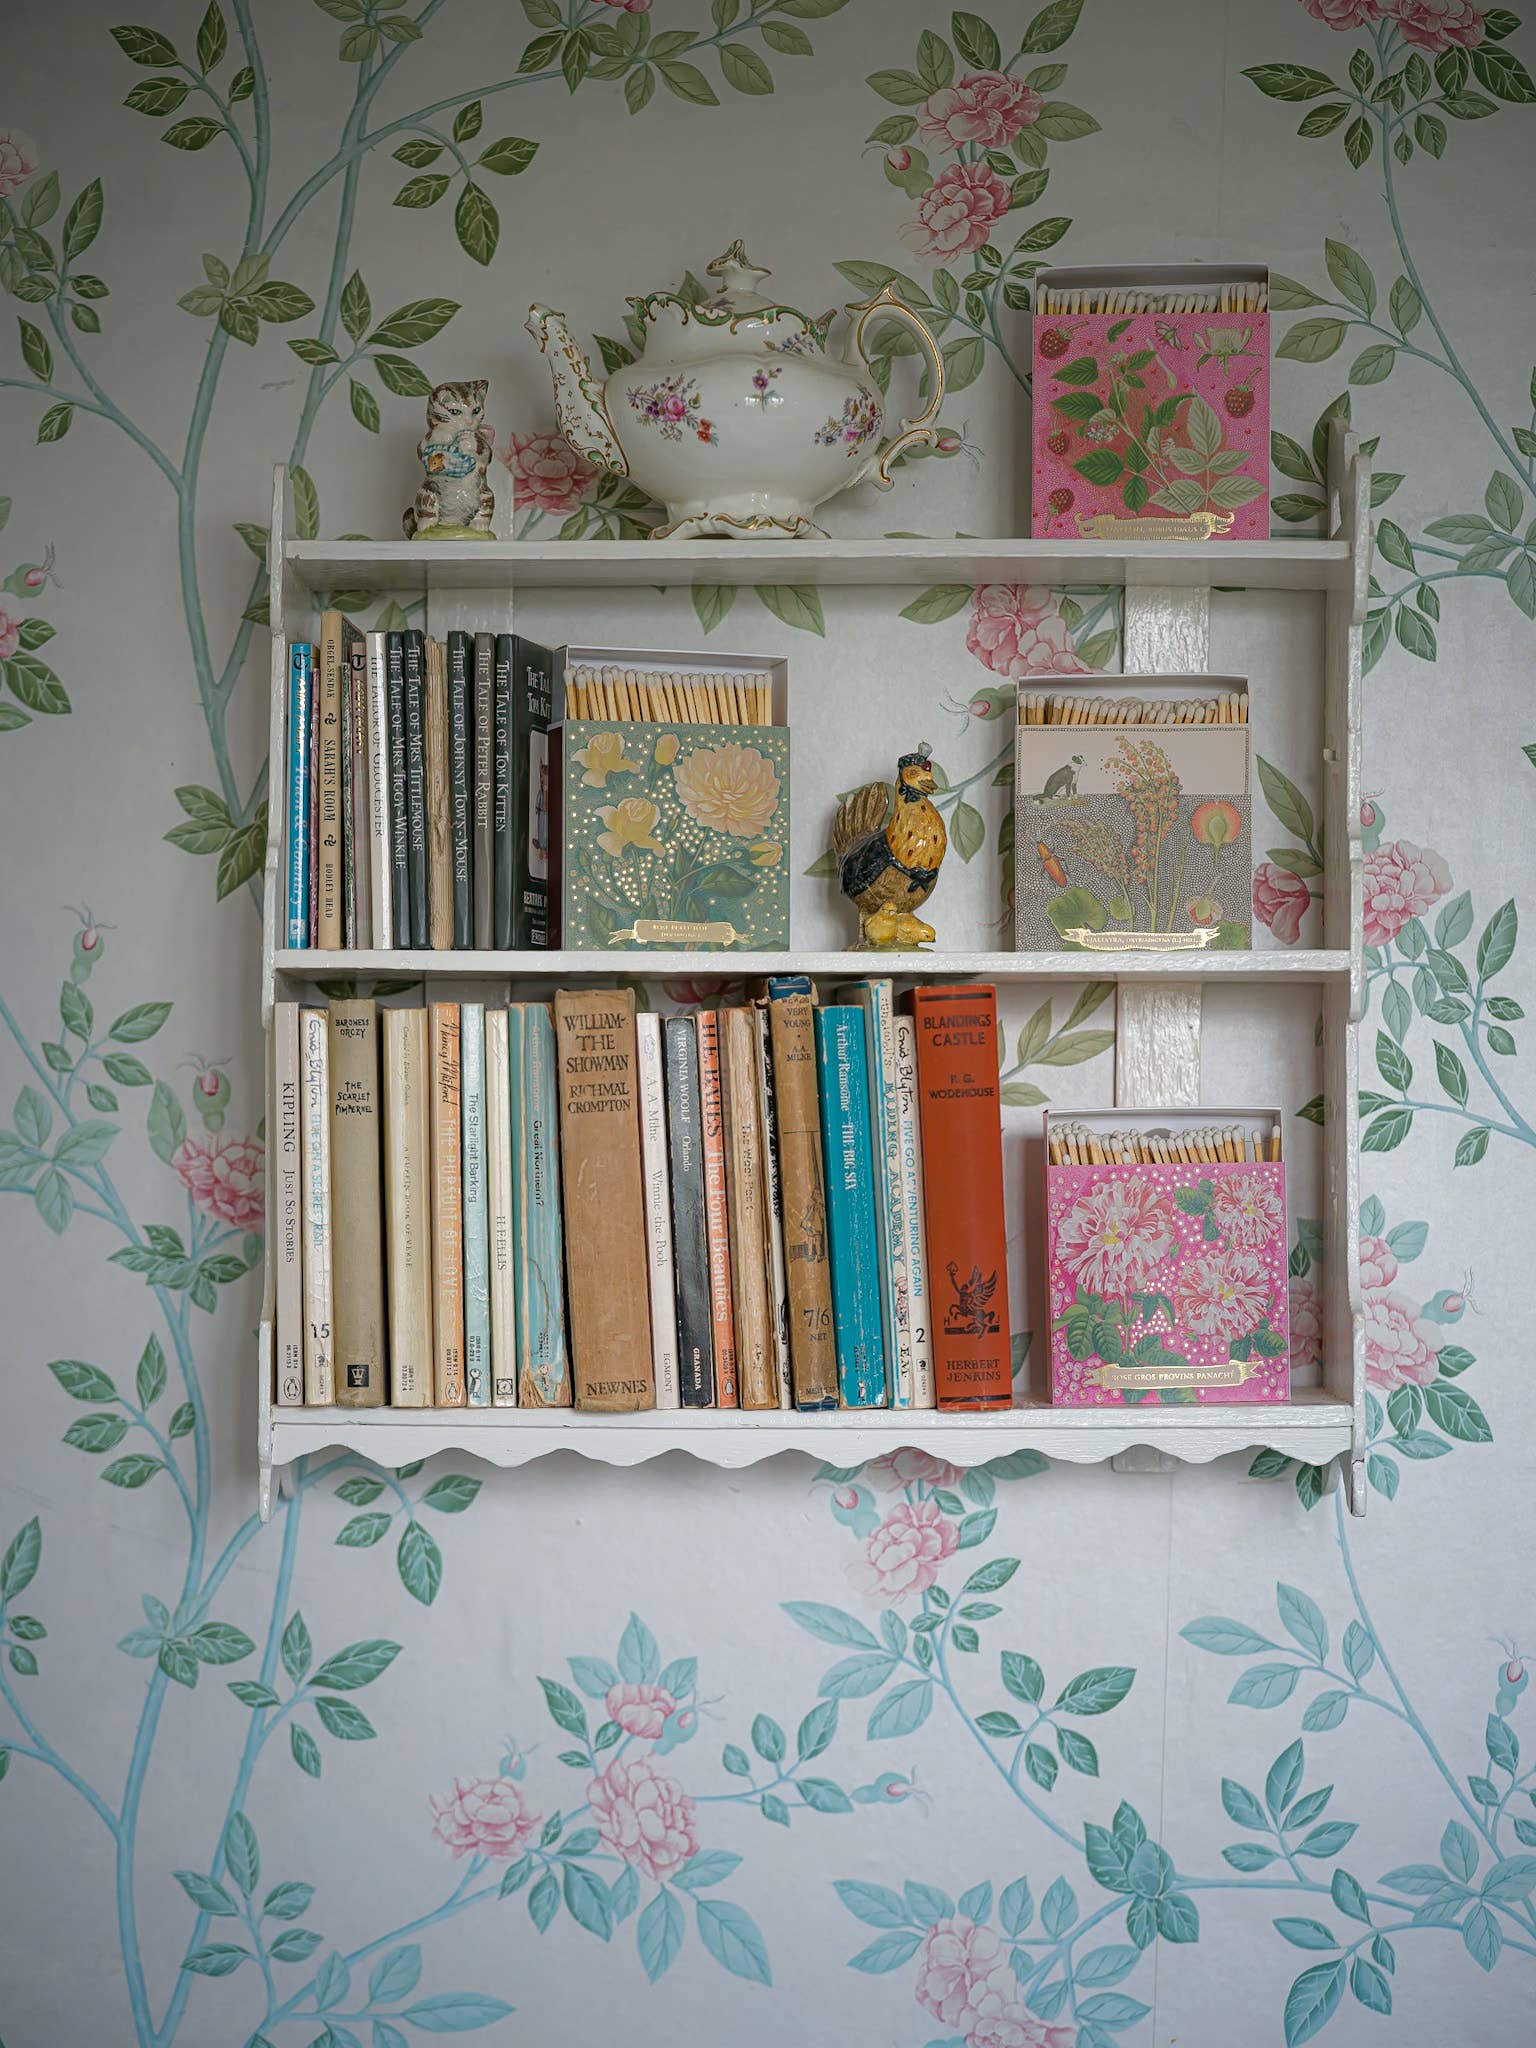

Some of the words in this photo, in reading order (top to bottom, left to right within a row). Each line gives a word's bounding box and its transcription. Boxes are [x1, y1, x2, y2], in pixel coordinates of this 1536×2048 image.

[325, 639, 336, 699] ORGEL-SENDAK
[390, 645, 403, 671] THE
[408, 644, 420, 671] THE
[452, 647, 466, 673] THE
[478, 649, 491, 674] THE
[496, 660, 510, 687] THE
[390, 676, 403, 709] TALE
[408, 675, 421, 708] TALE
[453, 676, 467, 710] TALE
[478, 678, 491, 711] TALE
[409, 712, 421, 729] OF
[496, 691, 510, 724] TALE
[392, 714, 403, 732] OF
[454, 714, 466, 732] OF
[478, 715, 489, 732] OF
[496, 728, 507, 746] OF
[324, 739, 337, 785] SARAH'S
[453, 734, 467, 787] JOHNNY
[477, 736, 491, 776] PETER
[496, 751, 509, 778] TOM
[324, 790, 337, 822] ROOM
[374, 753, 387, 838] GLOUCESTER
[410, 765, 424, 851] TITTLEMOUSE
[475, 781, 491, 829] RABBIT
[496, 783, 509, 832] KITTEN
[392, 769, 408, 869] TIGGY-WINKLE
[290, 838, 308, 905] Country
[325, 863, 335, 892] BODLEY
[325, 897, 335, 918] HEAD
[784, 1019, 811, 1029] YOUNG
[786, 1007, 808, 1016] VERY
[923, 1014, 992, 1029] BLANDINGS
[308, 1019, 322, 1053] Enid
[340, 1028, 366, 1039] ORCZY
[438, 1022, 460, 1059] Nancy
[576, 1034, 615, 1051] THE
[836, 1024, 850, 1062] Arthur
[898, 1027, 911, 1060] Enid
[932, 1032, 985, 1047] CASTLE
[566, 1055, 629, 1073] SHOWMAN
[677, 1029, 689, 1081] VIRGINIA
[786, 1053, 811, 1062] MILNE
[345, 1081, 362, 1091] THE
[438, 1060, 459, 1106] Mitford
[569, 1083, 629, 1098] RICHMAL
[838, 1063, 851, 1111] Ransome
[896, 1065, 914, 1115] Blyton
[963, 1073, 975, 1083] G.
[337, 1092, 371, 1101] SCARLET
[469, 1093, 479, 1112] The
[568, 1099, 631, 1114] CROMPTON
[679, 1083, 691, 1124] WOOLF
[705, 1069, 722, 1138] BATES
[929, 1087, 995, 1099] WODEHOUSE
[283, 1082, 296, 1153] KIPLING
[648, 1110, 661, 1142] Milne
[903, 1120, 914, 1144] FIVE
[441, 1118, 457, 1147] THE
[467, 1115, 480, 1159] Starlight
[533, 1120, 543, 1150] Great
[841, 1121, 856, 1147] THE
[682, 1136, 693, 1172] Orlando
[707, 1150, 725, 1184] The
[843, 1149, 857, 1169] BIG
[905, 1147, 916, 1168] GO
[284, 1169, 296, 1194] JUST
[441, 1154, 458, 1220] PURSUIT
[467, 1163, 480, 1203] Barking
[534, 1153, 545, 1206] Northern?
[845, 1171, 858, 1191] SIX
[285, 1200, 297, 1215] SO
[709, 1189, 726, 1232] Four
[286, 1218, 297, 1263] STORIES
[442, 1229, 458, 1249] OF
[711, 1236, 730, 1322] Beauties
[912, 1258, 923, 1297] AGAIN
[810, 1333, 827, 1341] NET
[916, 1328, 926, 1344] 2
[662, 1353, 673, 1393] EGMONT
[692, 1347, 703, 1391] GRANADA
[946, 1358, 1000, 1370] HERBERT
[946, 1371, 1001, 1382] JENKINS
[1134, 1373, 1156, 1381] GROS
[1158, 1372, 1195, 1381] PROVINS
[586, 1380, 648, 1396] NEWNES
